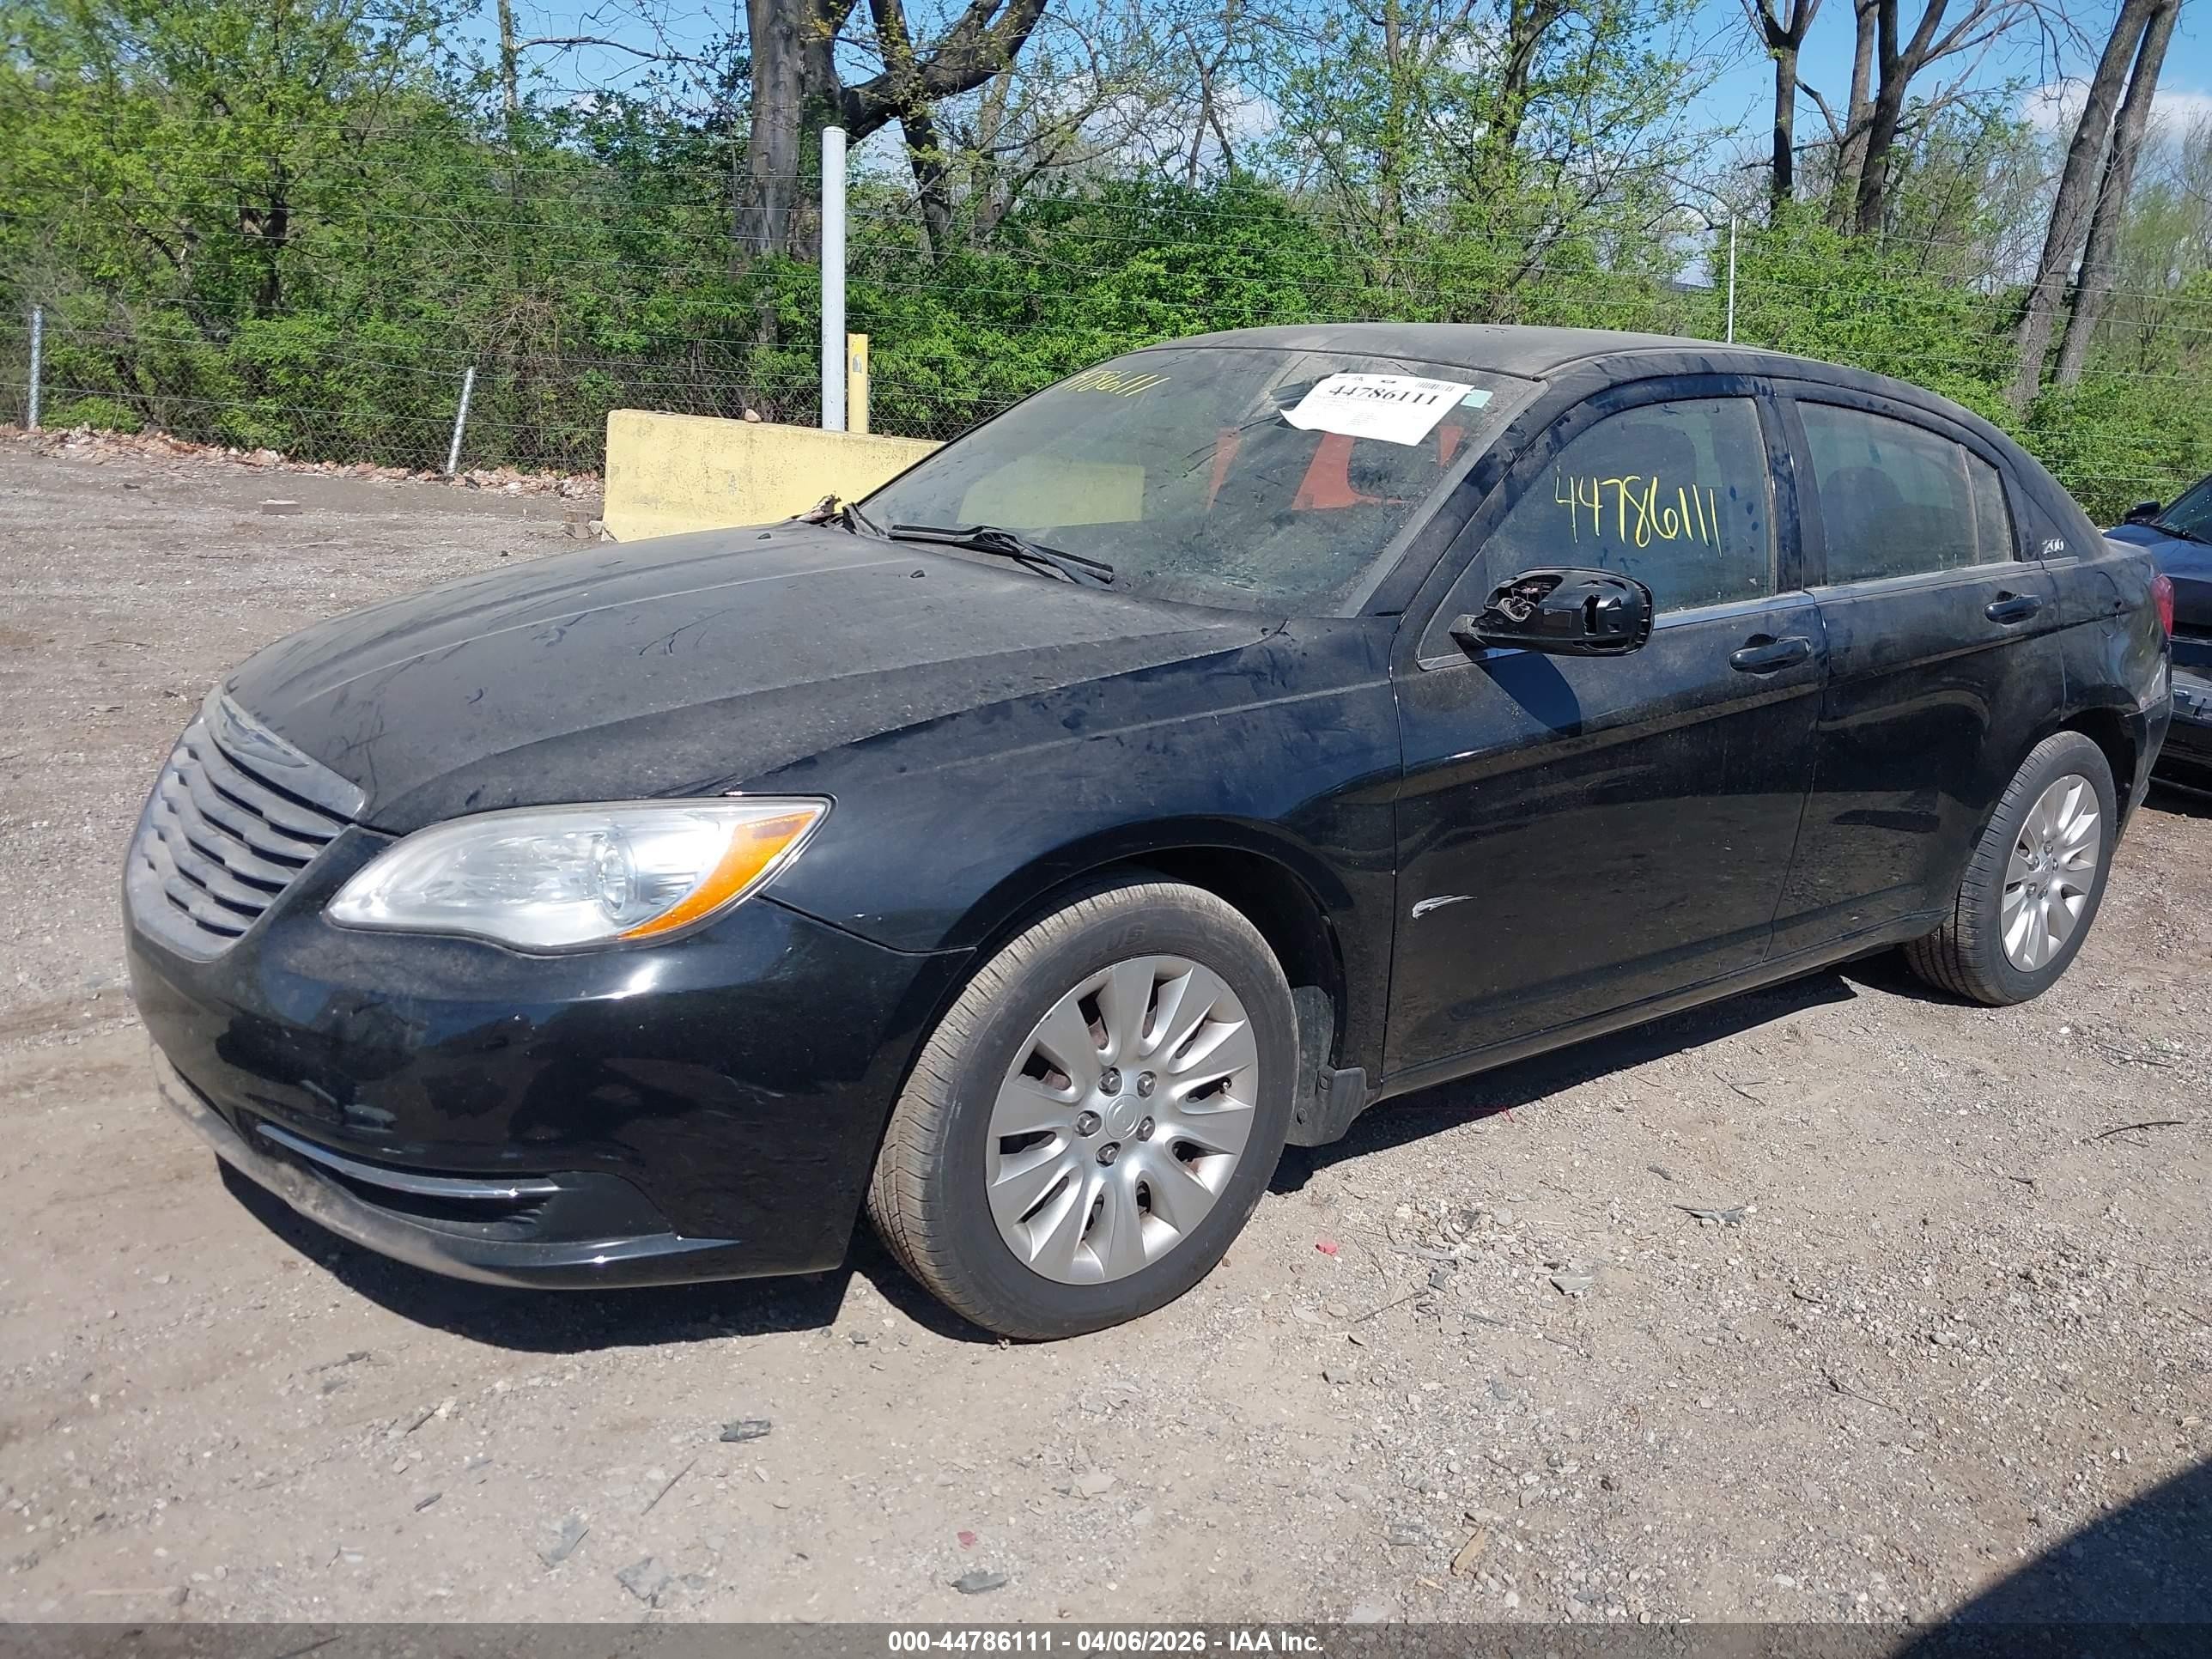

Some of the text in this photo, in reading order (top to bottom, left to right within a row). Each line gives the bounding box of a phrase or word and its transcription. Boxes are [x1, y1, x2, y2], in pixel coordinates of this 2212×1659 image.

[1328, 385, 1440, 405] 44786111
[1554, 475, 1723, 559] 44786111
[2040, 538, 2064, 555] 200
